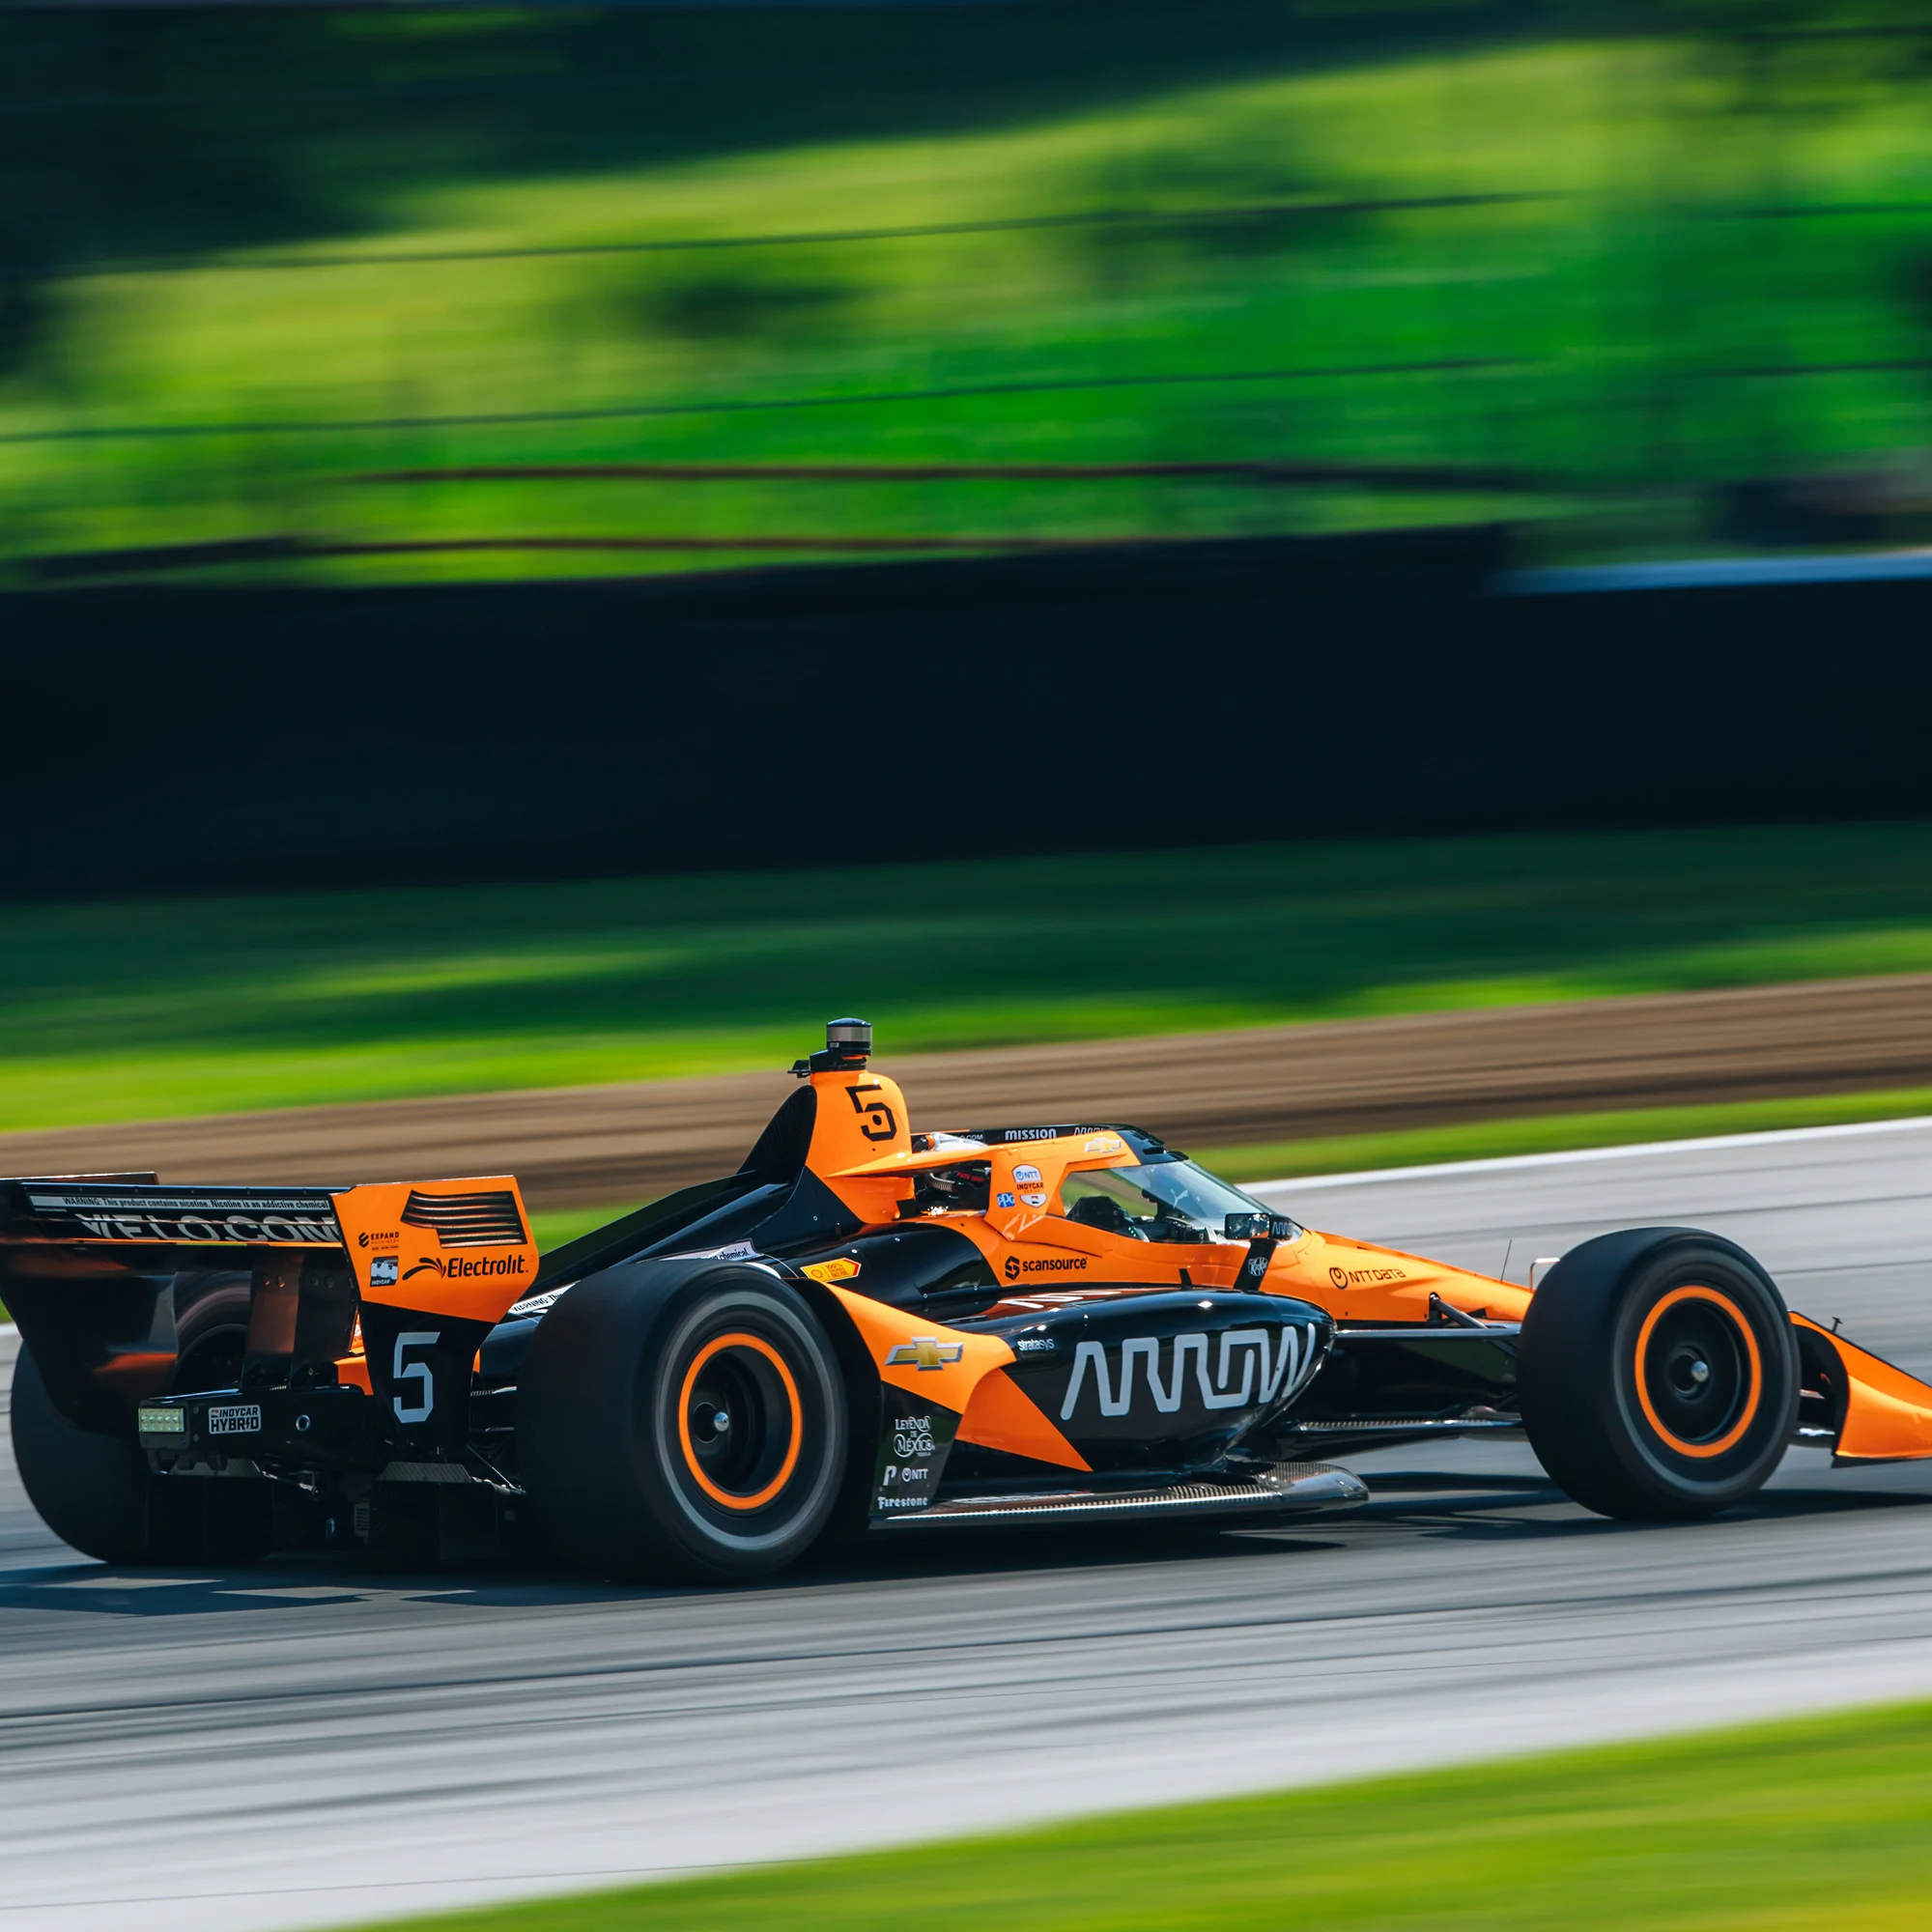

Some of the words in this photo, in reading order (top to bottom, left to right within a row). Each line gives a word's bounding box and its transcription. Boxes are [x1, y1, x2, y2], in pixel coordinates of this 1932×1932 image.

[844, 1084, 897, 1142] 5
[1016, 1181, 1044, 1190] INDYCAR
[62, 1196, 102, 1206] WARNING:
[103, 1197, 118, 1206] This
[120, 1198, 147, 1208] product
[179, 1199, 211, 1208] nicotine.
[211, 1199, 242, 1208] Nicotine
[370, 1232, 400, 1240] EXPAND
[1022, 1258, 1087, 1272] scansource
[1349, 1269, 1373, 1284] NTT
[1017, 1338, 1055, 1351] stratasys
[393, 1331, 440, 1424] 5
[1061, 1321, 1316, 1420] ARROW
[219, 1406, 258, 1418] INDYCAR
[895, 1416, 931, 1432] LEYENDA
[911, 1468, 928, 1479] NTT
[877, 1496, 928, 1510] Firestone
